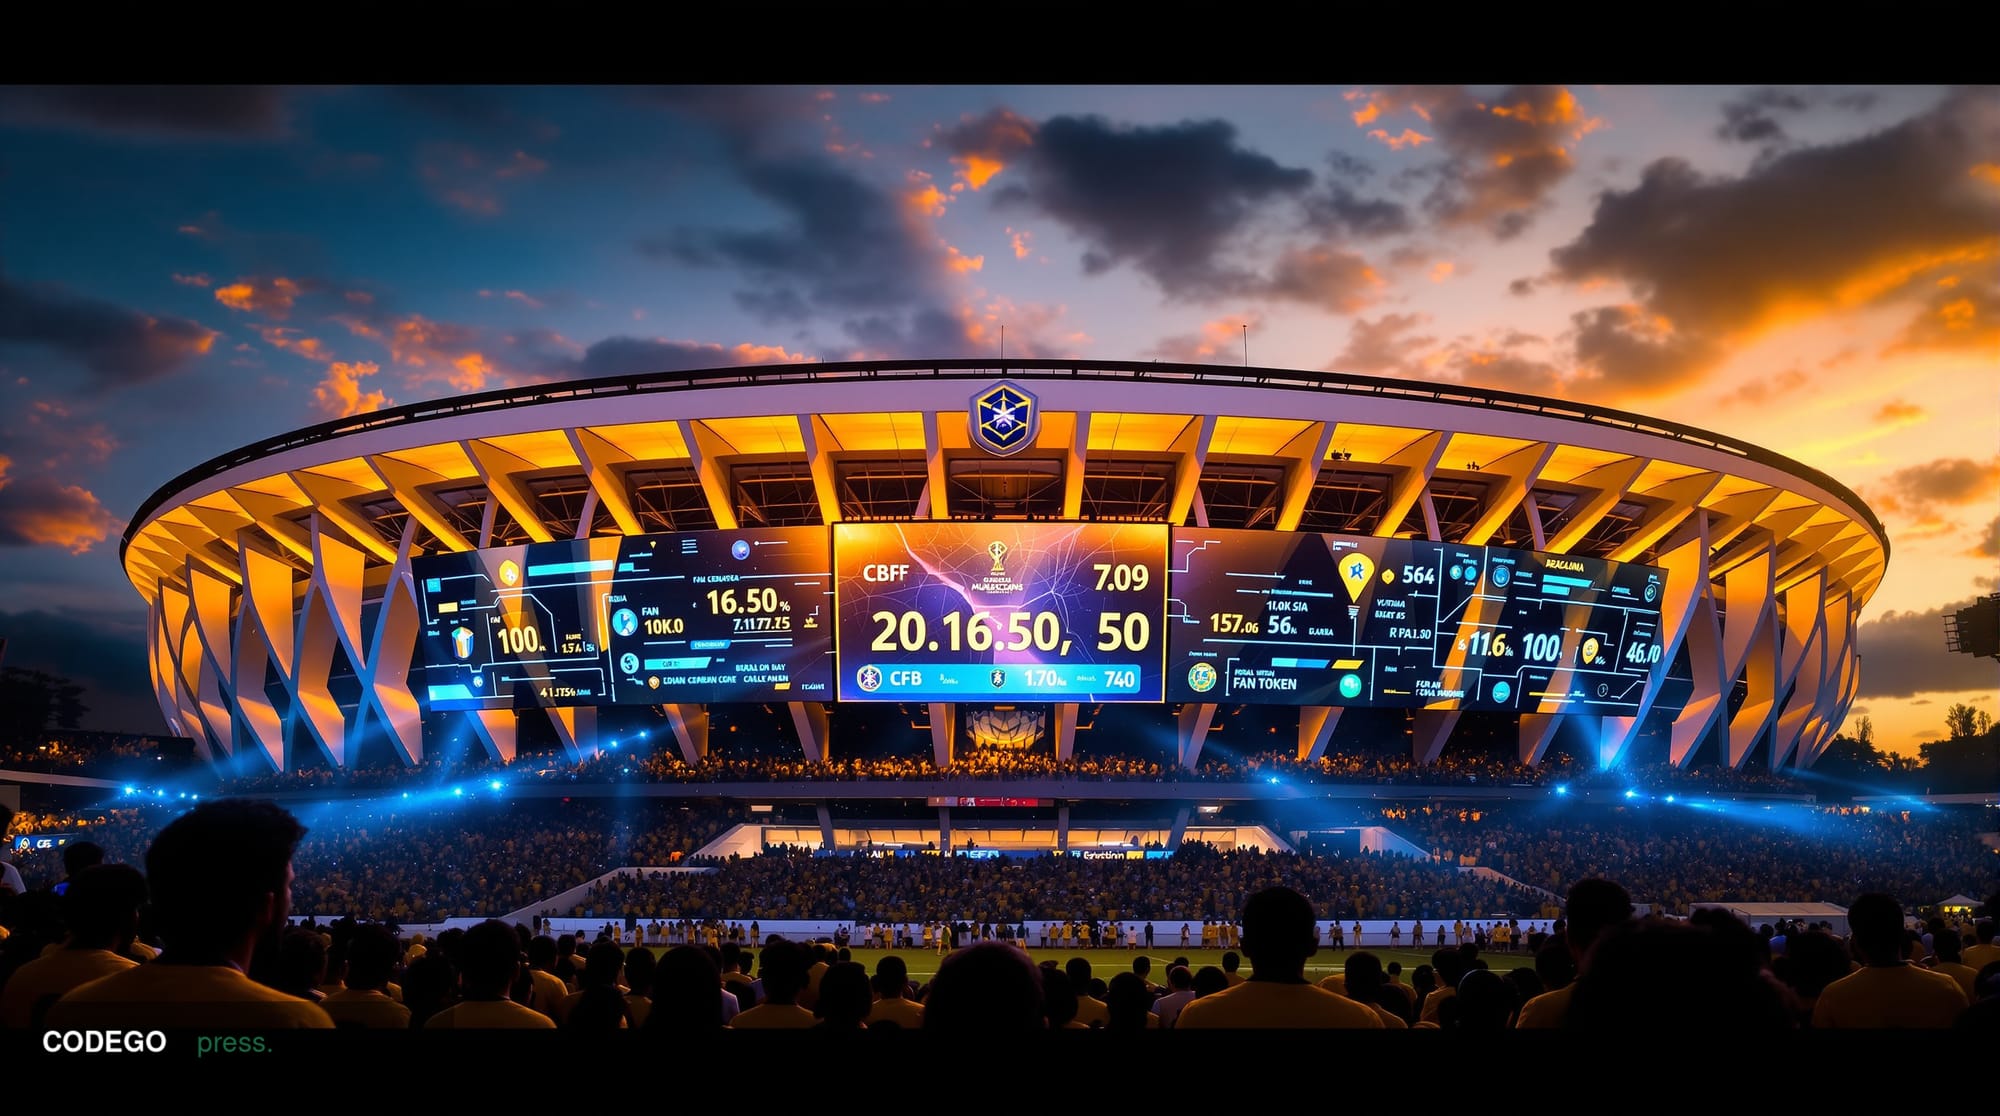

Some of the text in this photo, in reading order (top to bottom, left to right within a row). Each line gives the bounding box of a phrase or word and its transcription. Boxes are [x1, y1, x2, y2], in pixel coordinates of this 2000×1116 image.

[863, 564, 910, 582] CBFF
[1093, 563, 1149, 592] 7.09
[1402, 565, 1435, 585] 564
[641, 606, 659, 616] FAN
[644, 617, 684, 635] 10K.0
[1097, 611, 1150, 652] 50
[890, 670, 922, 686] CFB
[1104, 670, 1135, 688] 740
[1233, 677, 1297, 690] FAN TOKEN
